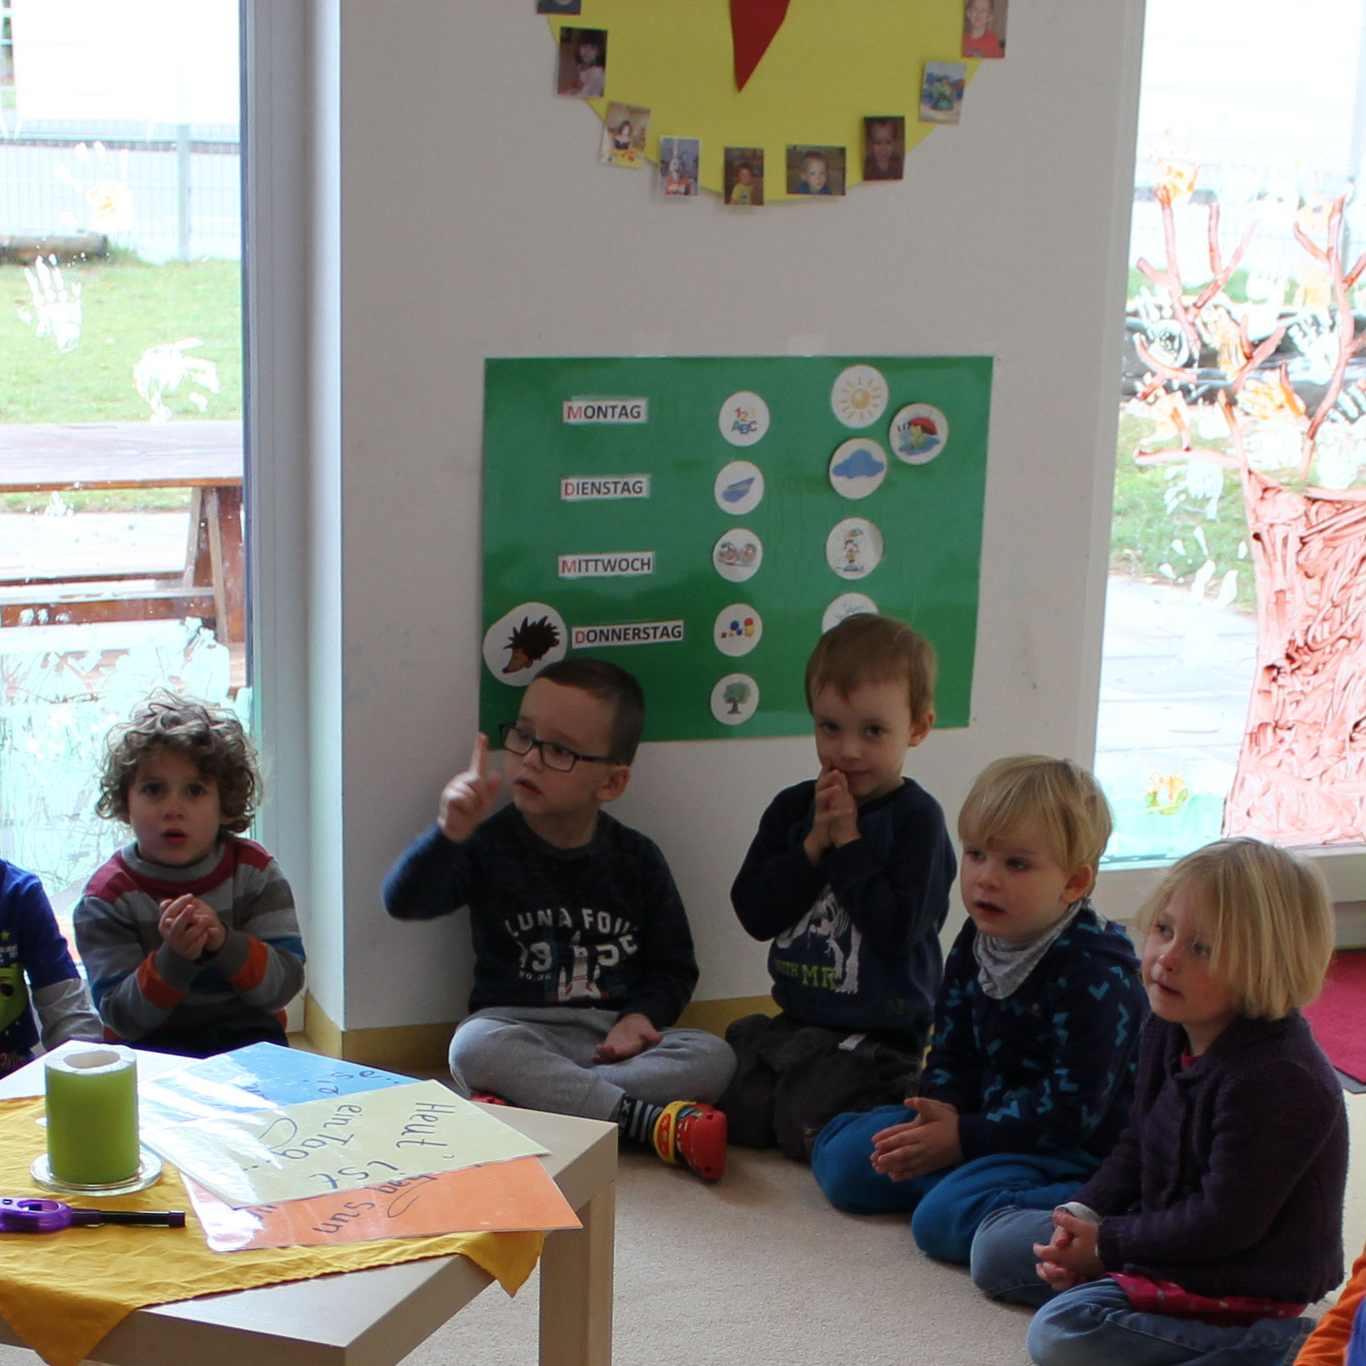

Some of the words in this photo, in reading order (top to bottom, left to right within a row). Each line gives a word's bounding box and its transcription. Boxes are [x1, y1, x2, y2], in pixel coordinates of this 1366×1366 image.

[566, 404, 642, 420] MONTAG
[564, 479, 644, 497] DIENSTAG
[561, 556, 652, 574] MITTWOCH
[574, 624, 683, 645] DONNERSTAG
